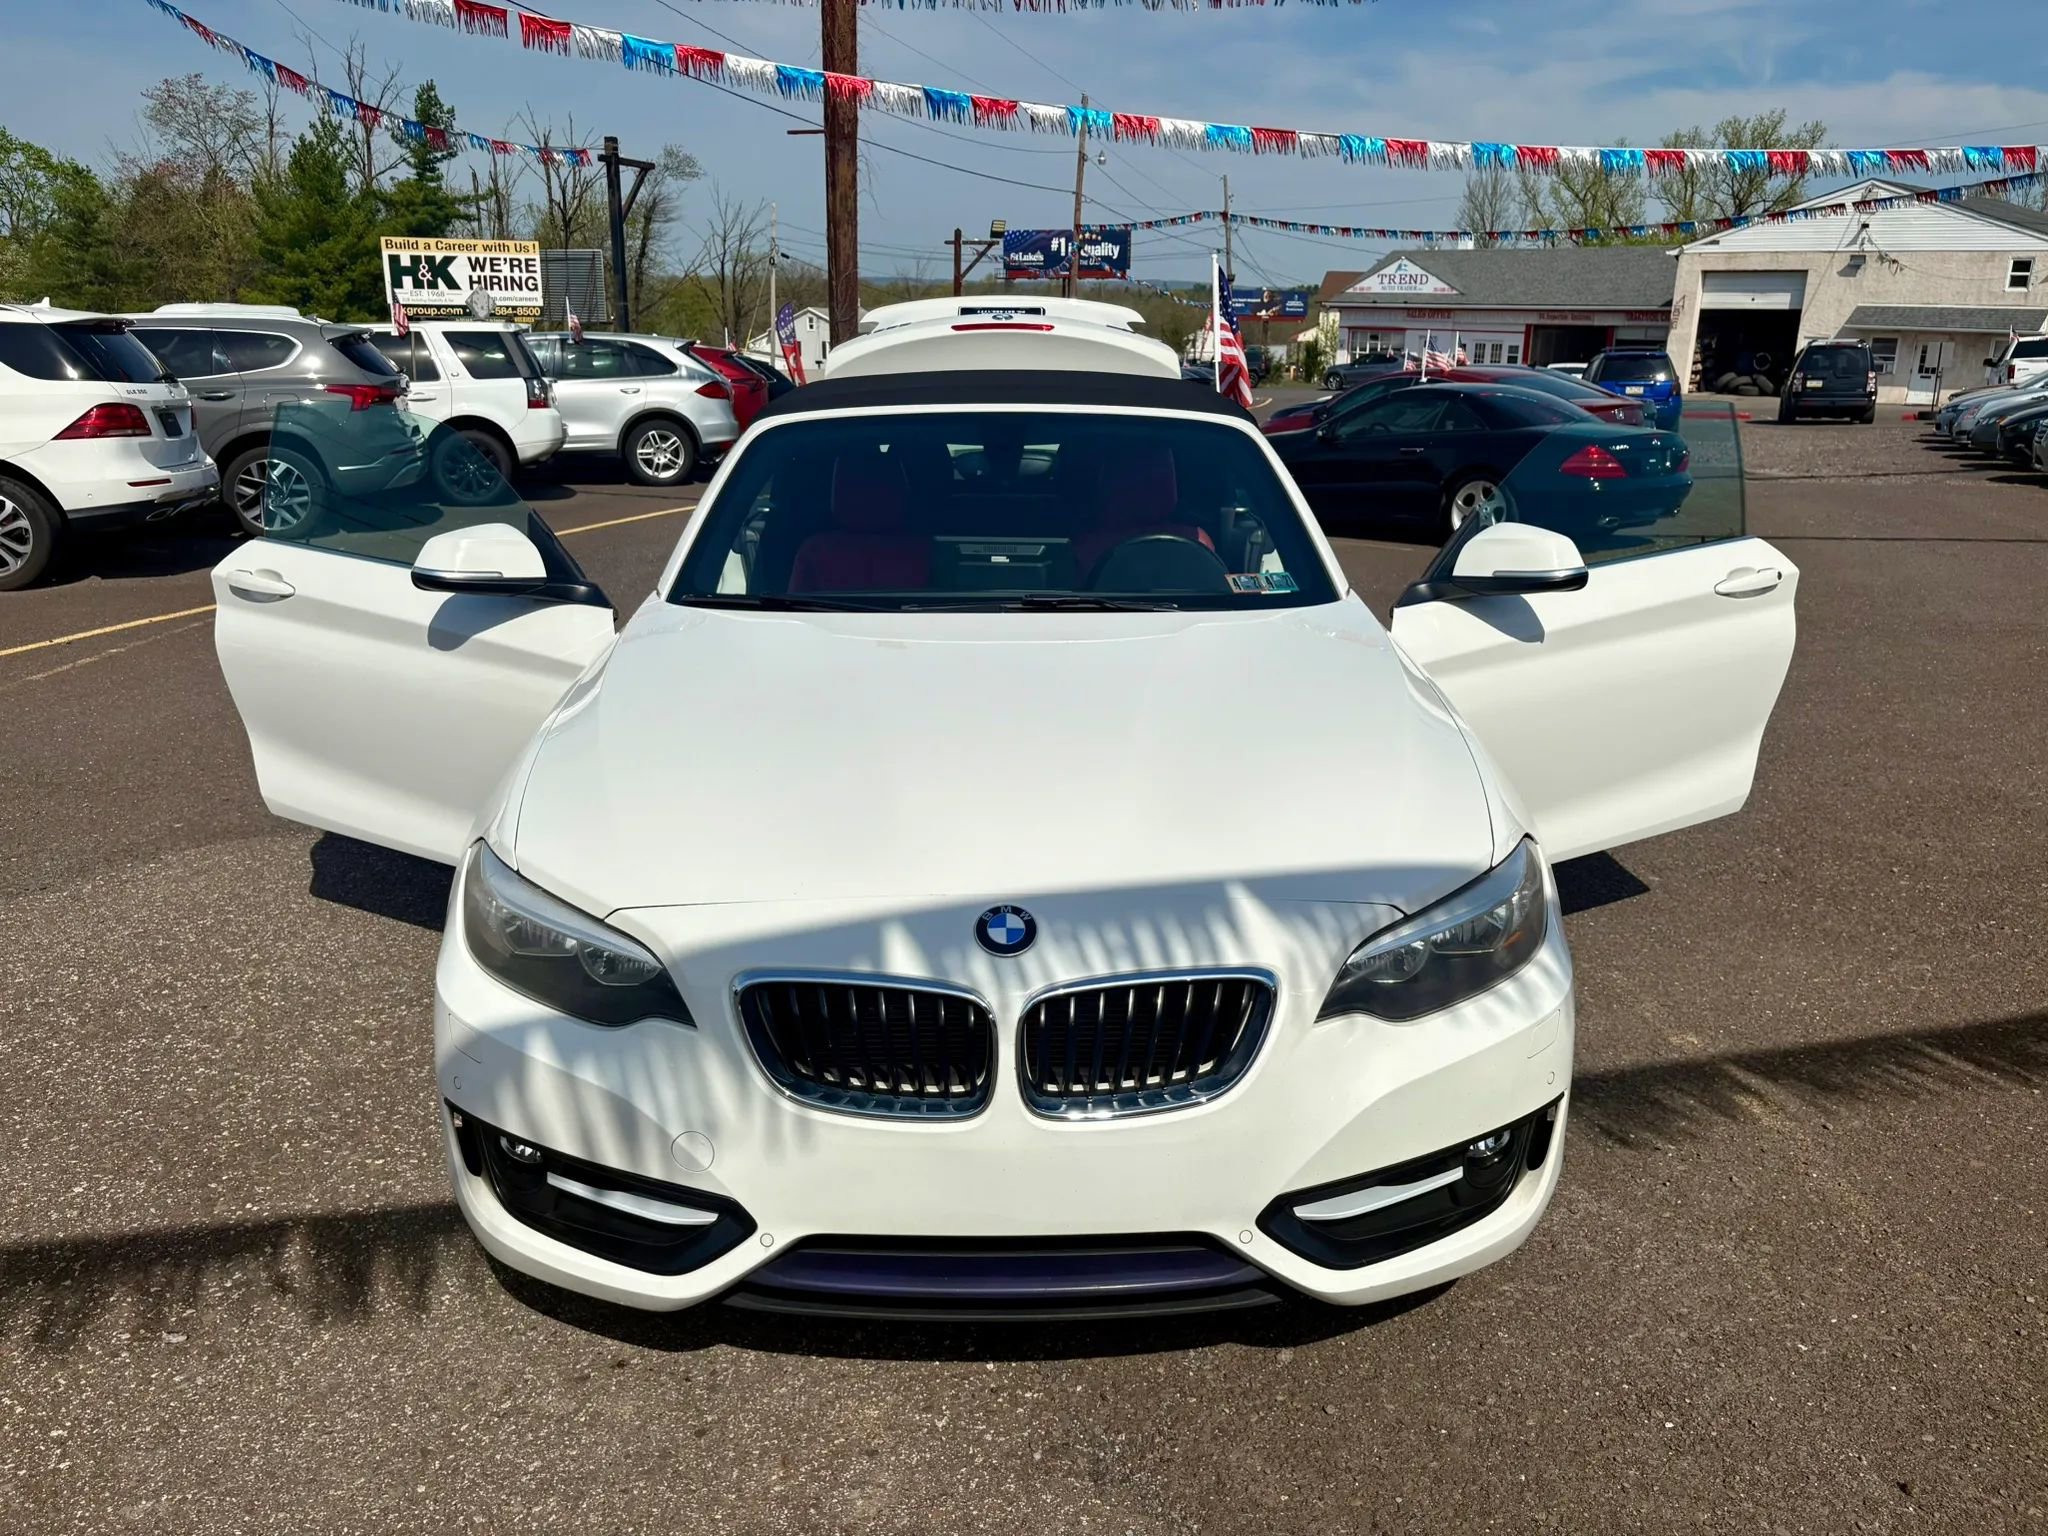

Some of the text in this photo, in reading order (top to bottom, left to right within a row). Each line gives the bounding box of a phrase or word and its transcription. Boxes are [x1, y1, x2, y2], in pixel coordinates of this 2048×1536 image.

[385, 239, 419, 250] Build
[423, 242, 431, 250] a
[435, 240, 478, 252] Career
[482, 242, 510, 253] with
[1051, 237, 1066, 256] #1
[388, 254, 462, 289] H&K
[467, 256, 538, 273] WE'RE
[468, 275, 539, 292] HIRING
[1377, 273, 1429, 285] TREND
[402, 306, 463, 316] kgroup.com
[491, 307, 541, 316] -584-8500
[982, 906, 1032, 921] BMW
